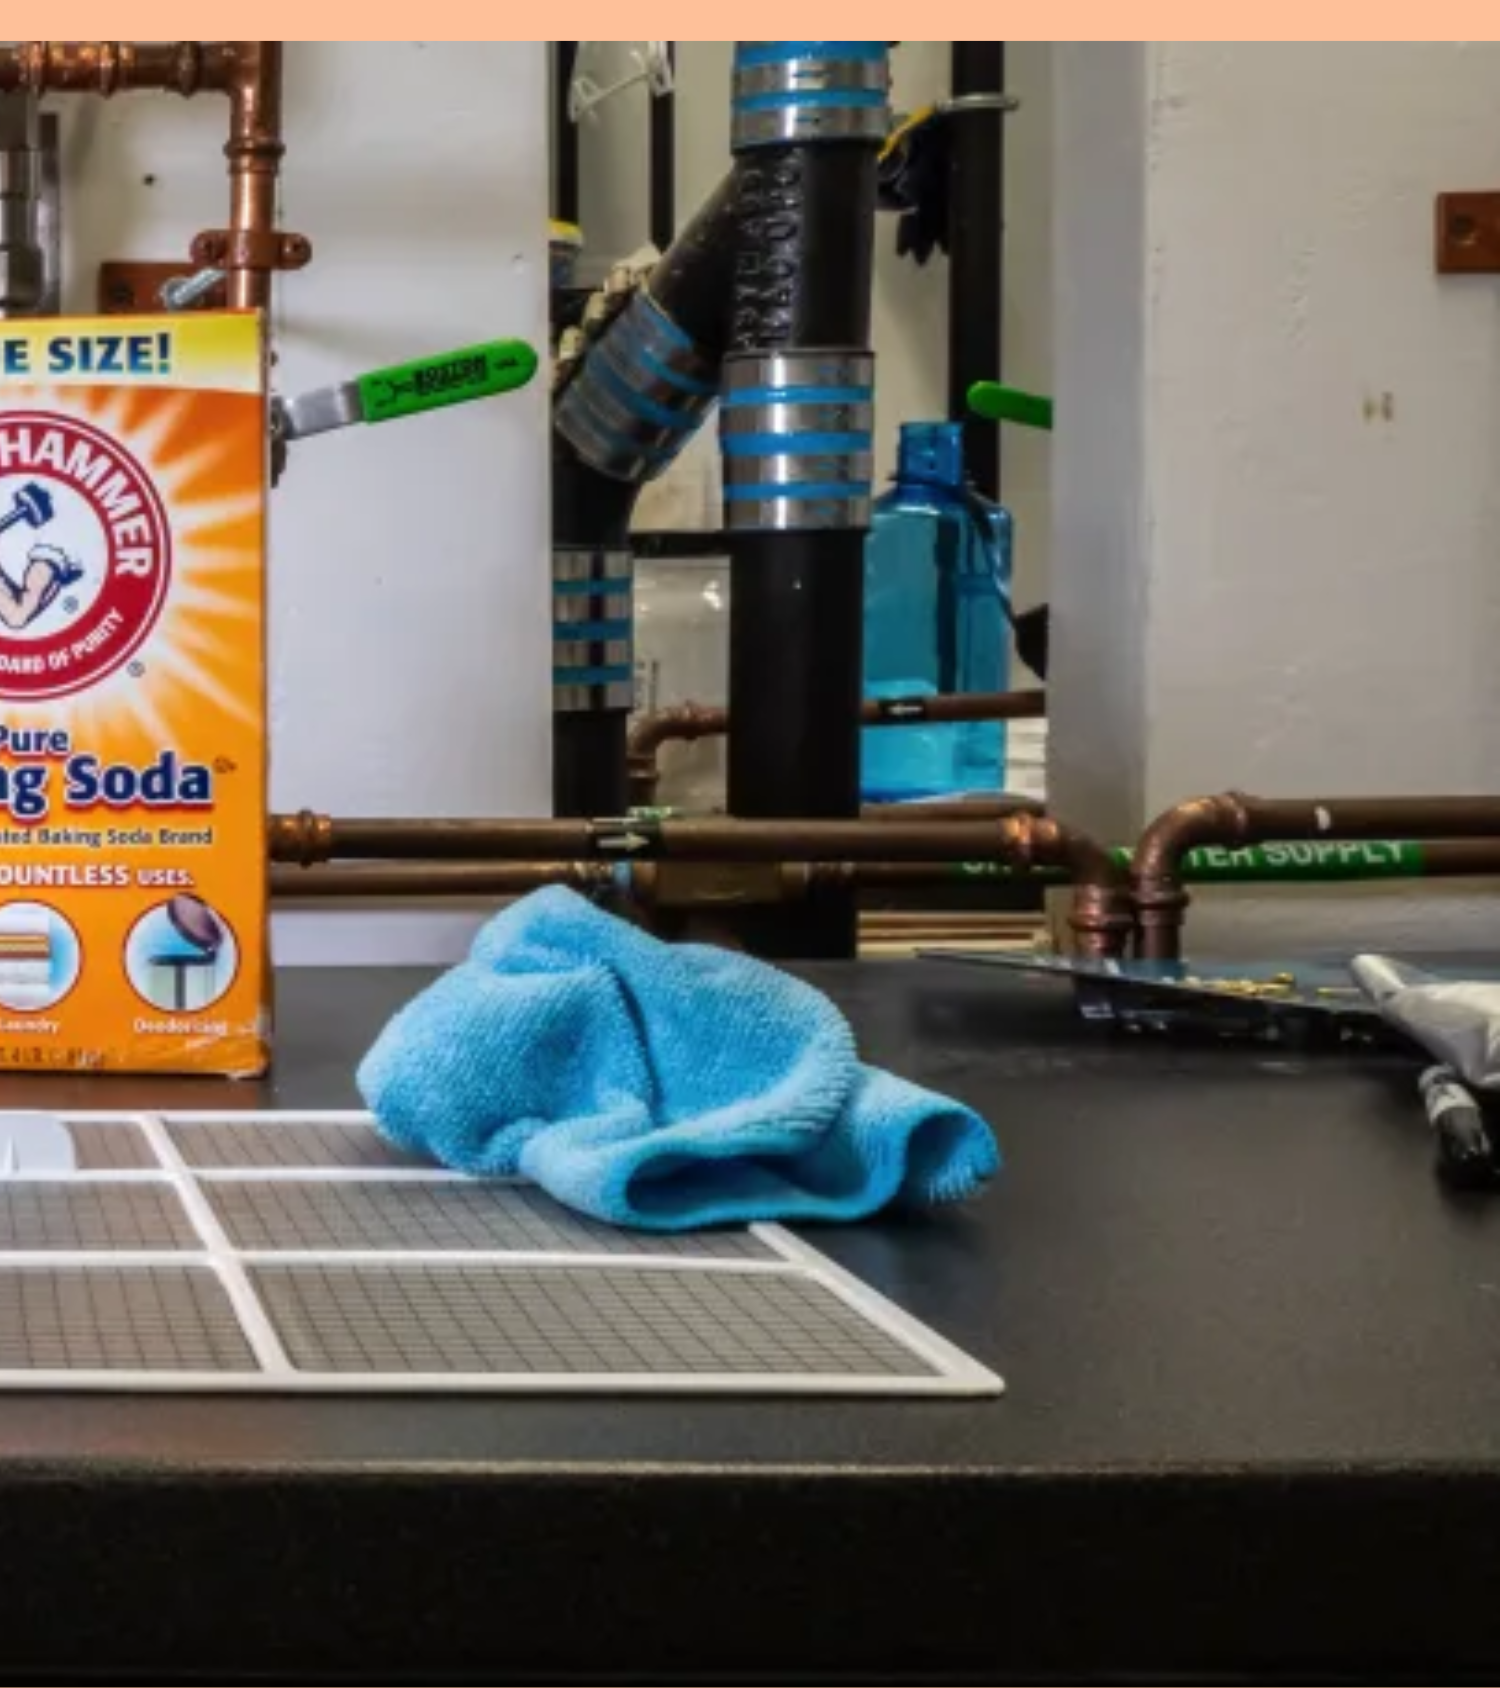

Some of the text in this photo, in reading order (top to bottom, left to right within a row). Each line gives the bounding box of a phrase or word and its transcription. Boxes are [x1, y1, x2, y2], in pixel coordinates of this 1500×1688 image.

[47, 331, 171, 376] SIZE!
[49, 647, 70, 670] OF
[69, 606, 125, 659] PURITY
[65, 750, 213, 808] Soda
[37, 828, 102, 849] Baking
[107, 828, 153, 846] Soda
[159, 828, 214, 846] Brand
[1260, 839, 1403, 867] SUPPLY
[137, 868, 195, 886] USES.
